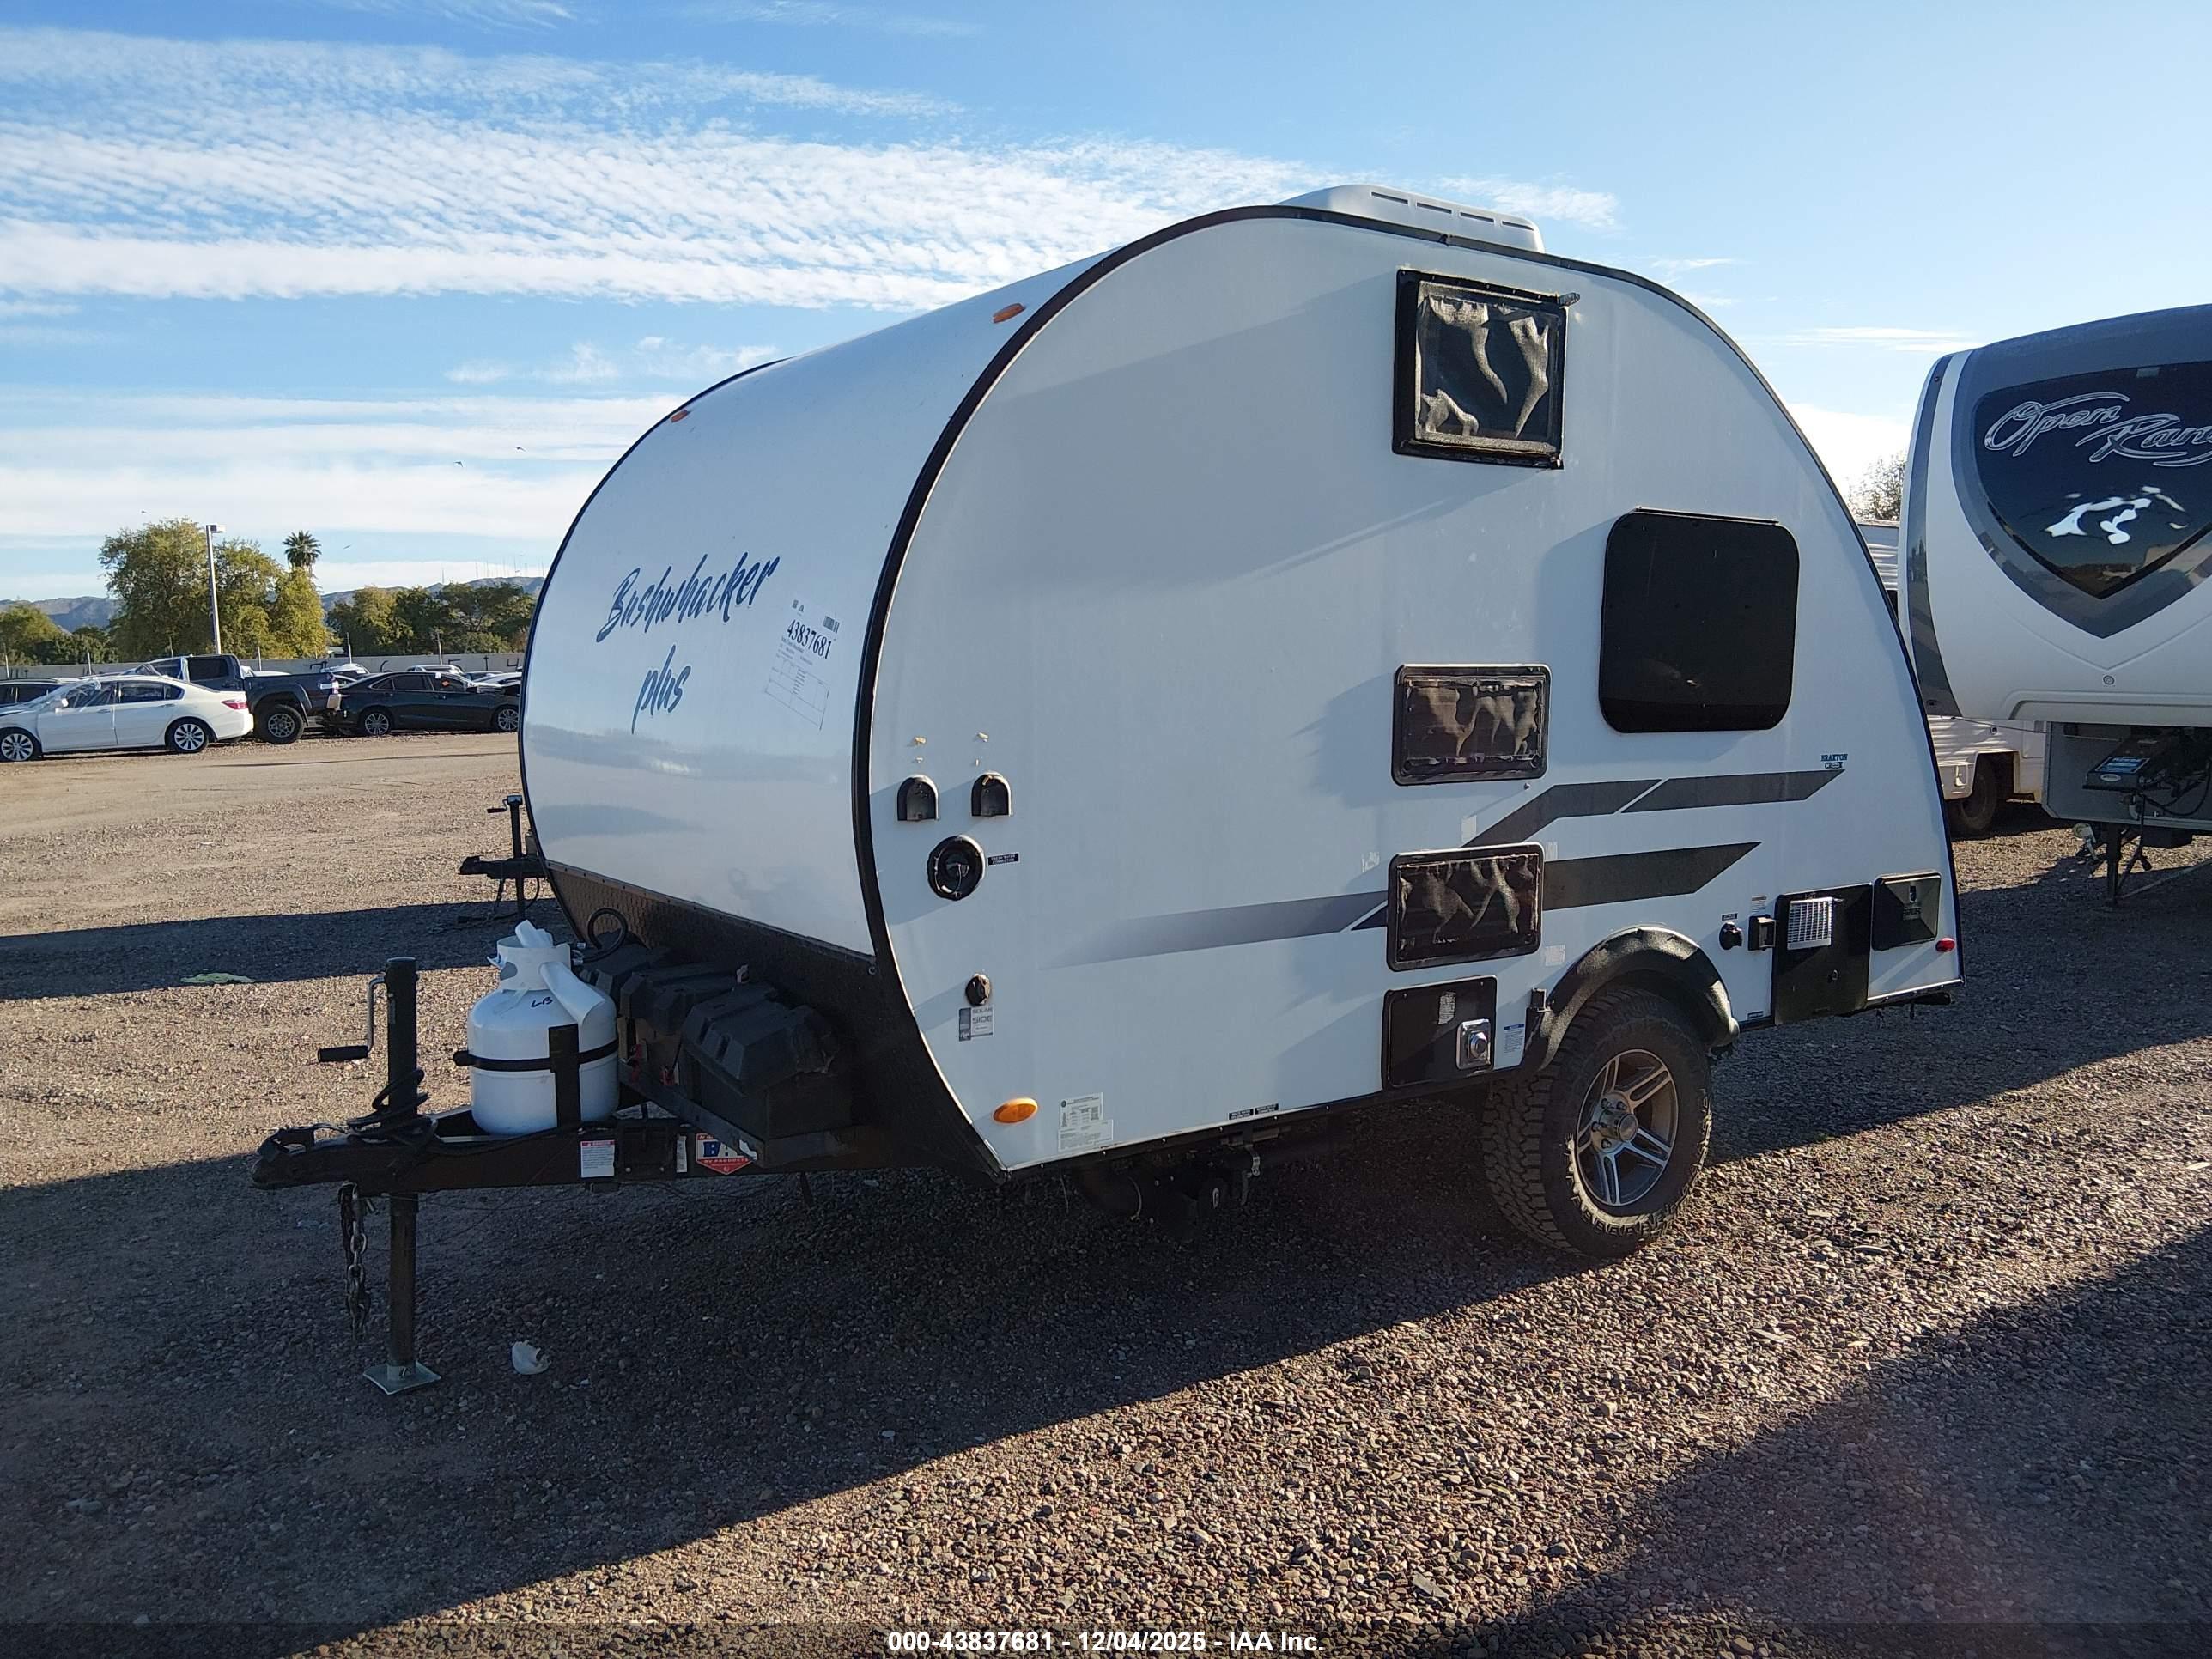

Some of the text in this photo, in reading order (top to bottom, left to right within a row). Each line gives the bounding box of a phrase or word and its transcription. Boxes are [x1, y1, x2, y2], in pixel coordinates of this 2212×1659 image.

[1984, 392, 2130, 457] Open
[596, 552, 781, 642] Bushwhacker
[787, 619, 832, 659] 43837681
[631, 645, 691, 734] plus
